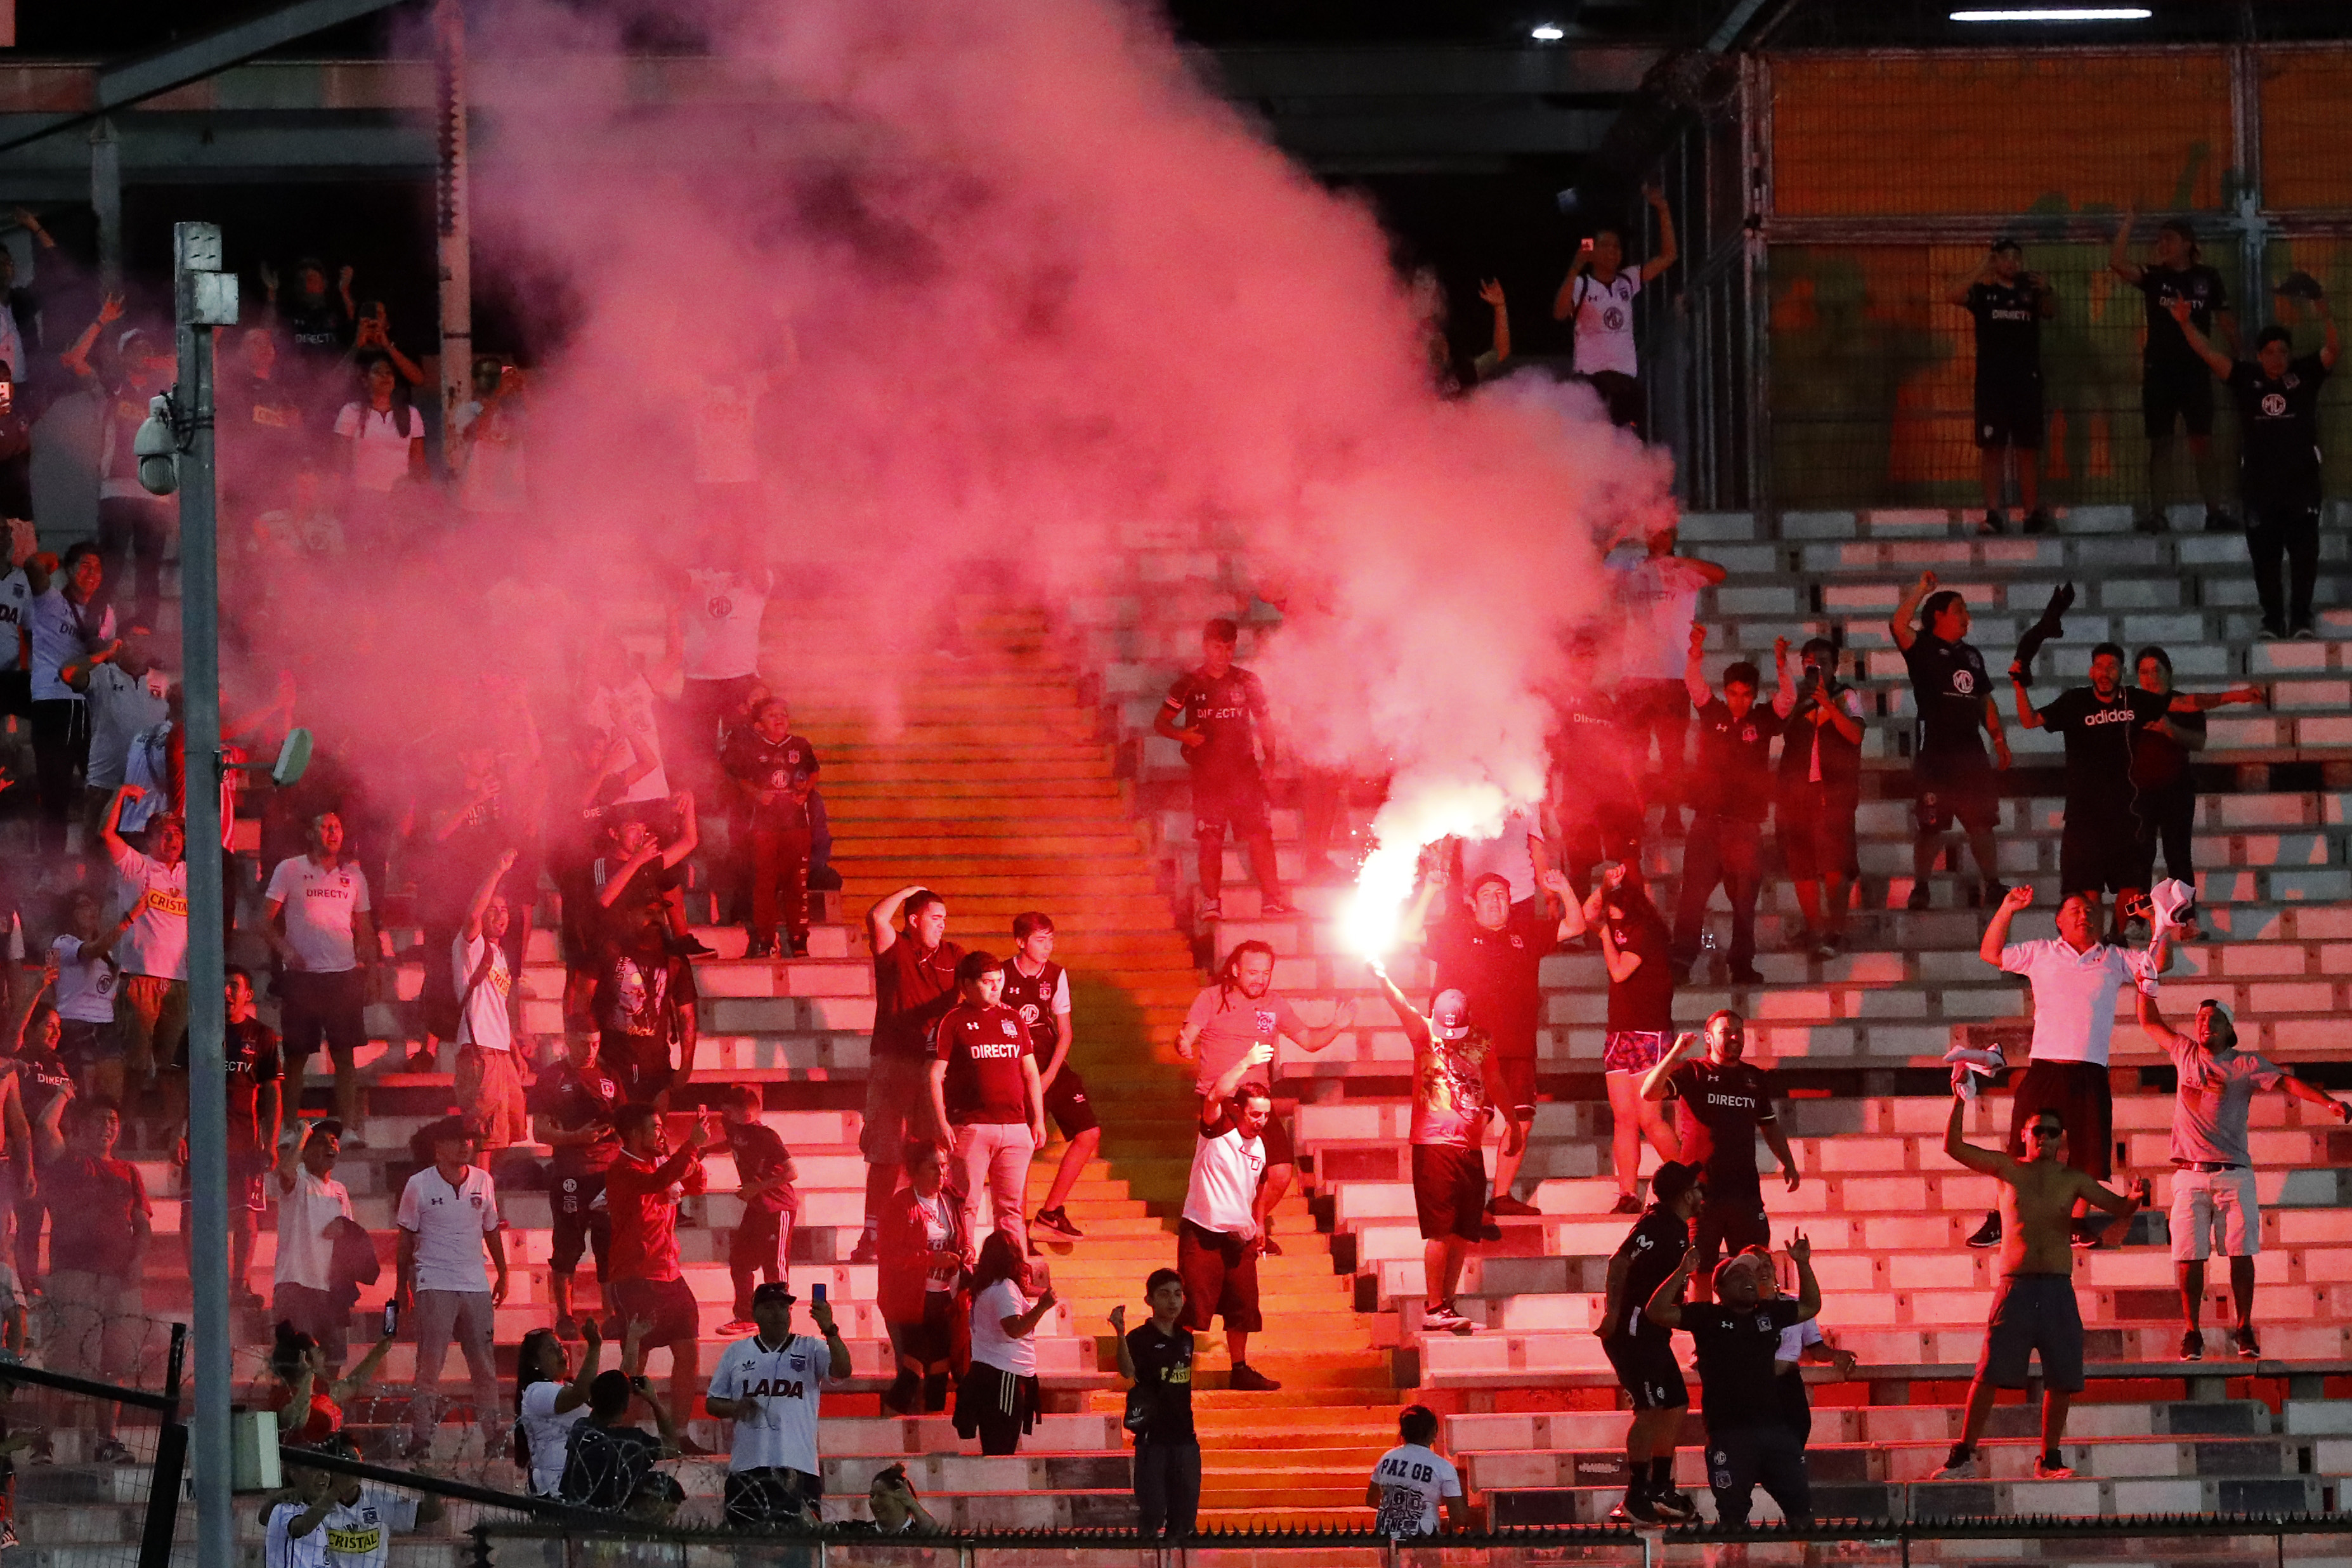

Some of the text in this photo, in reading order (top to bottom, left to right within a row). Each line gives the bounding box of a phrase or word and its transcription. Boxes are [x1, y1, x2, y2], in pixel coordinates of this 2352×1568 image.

[2084, 709, 2134, 726] adidas
[150, 893, 188, 912] CRISTA
[306, 889, 348, 899] DIRECTV
[971, 1044, 1020, 1059] DIRECTV
[1708, 1093, 1755, 1108] DIRECTV
[742, 1378, 804, 1399] LADA
[1381, 1459, 1433, 1482] PAZ GB
[328, 1530, 377, 1549] CRISTAL
